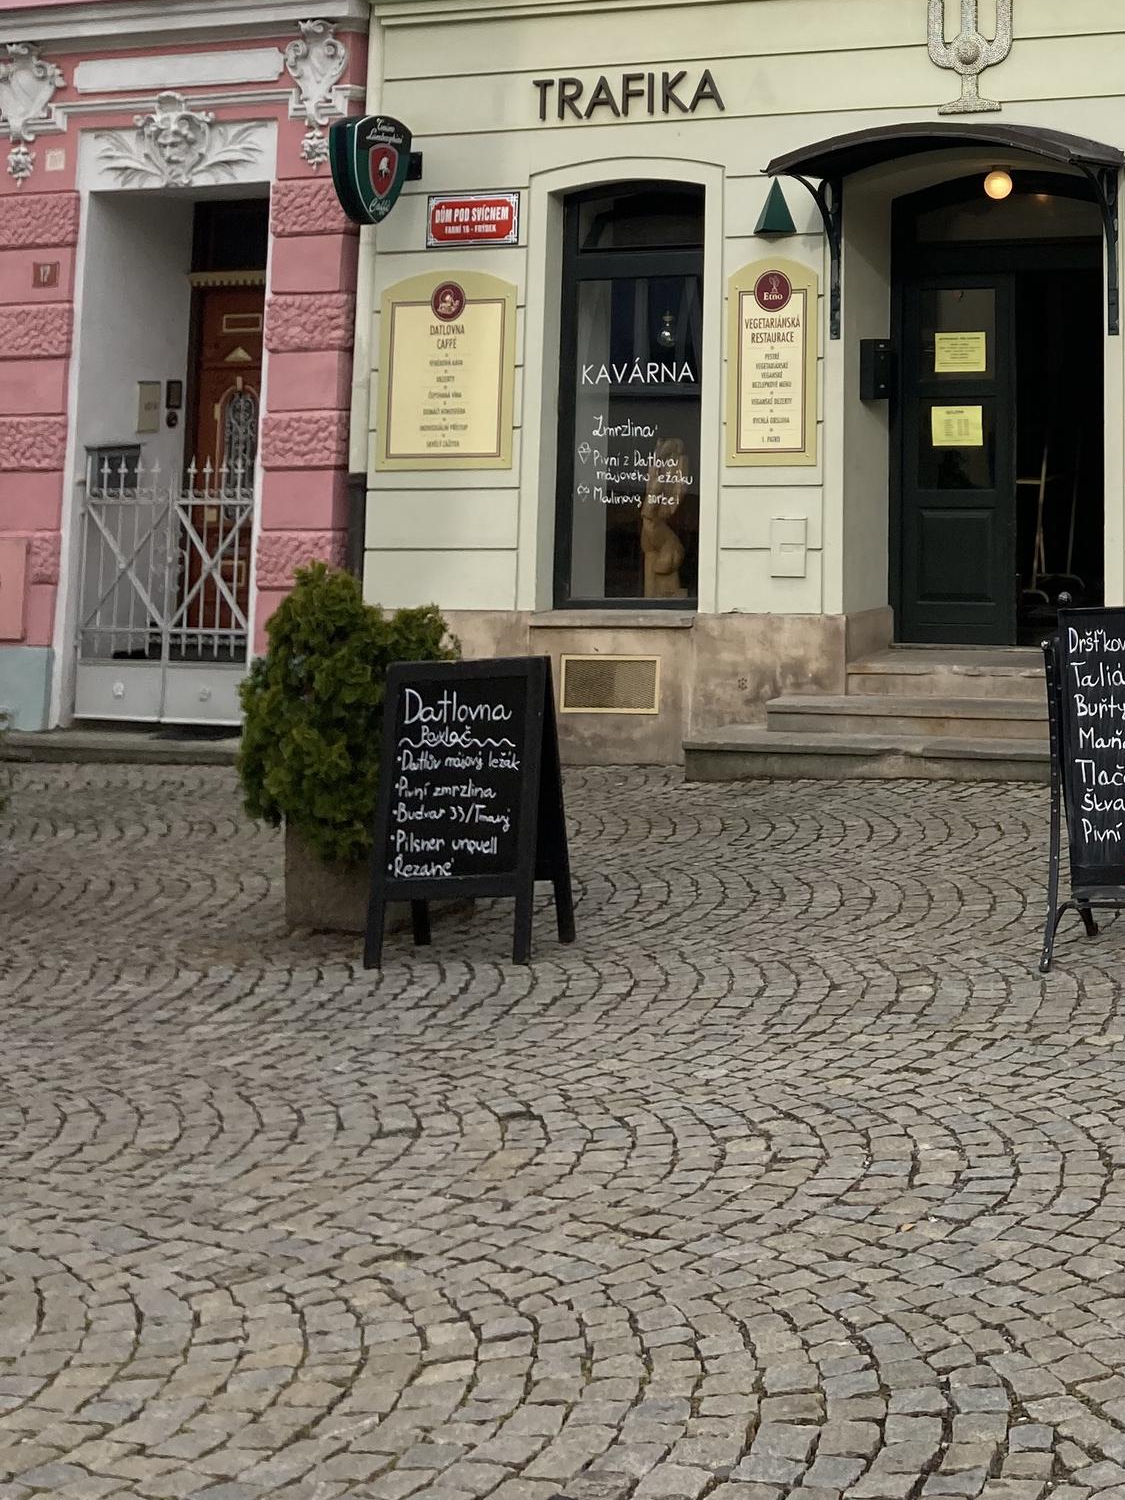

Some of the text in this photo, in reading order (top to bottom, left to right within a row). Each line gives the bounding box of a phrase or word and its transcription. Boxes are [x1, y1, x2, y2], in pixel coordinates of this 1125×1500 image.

[532, 69, 725, 121] TRAFIKA
[434, 204, 509, 224] DŮM POD SVÍCNEM
[763, 291, 784, 301] Etno
[430, 324, 465, 336] DATLOVNA
[745, 314, 801, 330] VEGETARIÁNSKÁ
[751, 331, 795, 344] RESTAURACE
[581, 357, 695, 385] KAVÁRNA
[404, 687, 512, 725] Datlovna
[433, 778, 497, 799] zmrzlina
[1082, 818, 1123, 845] Pivní
